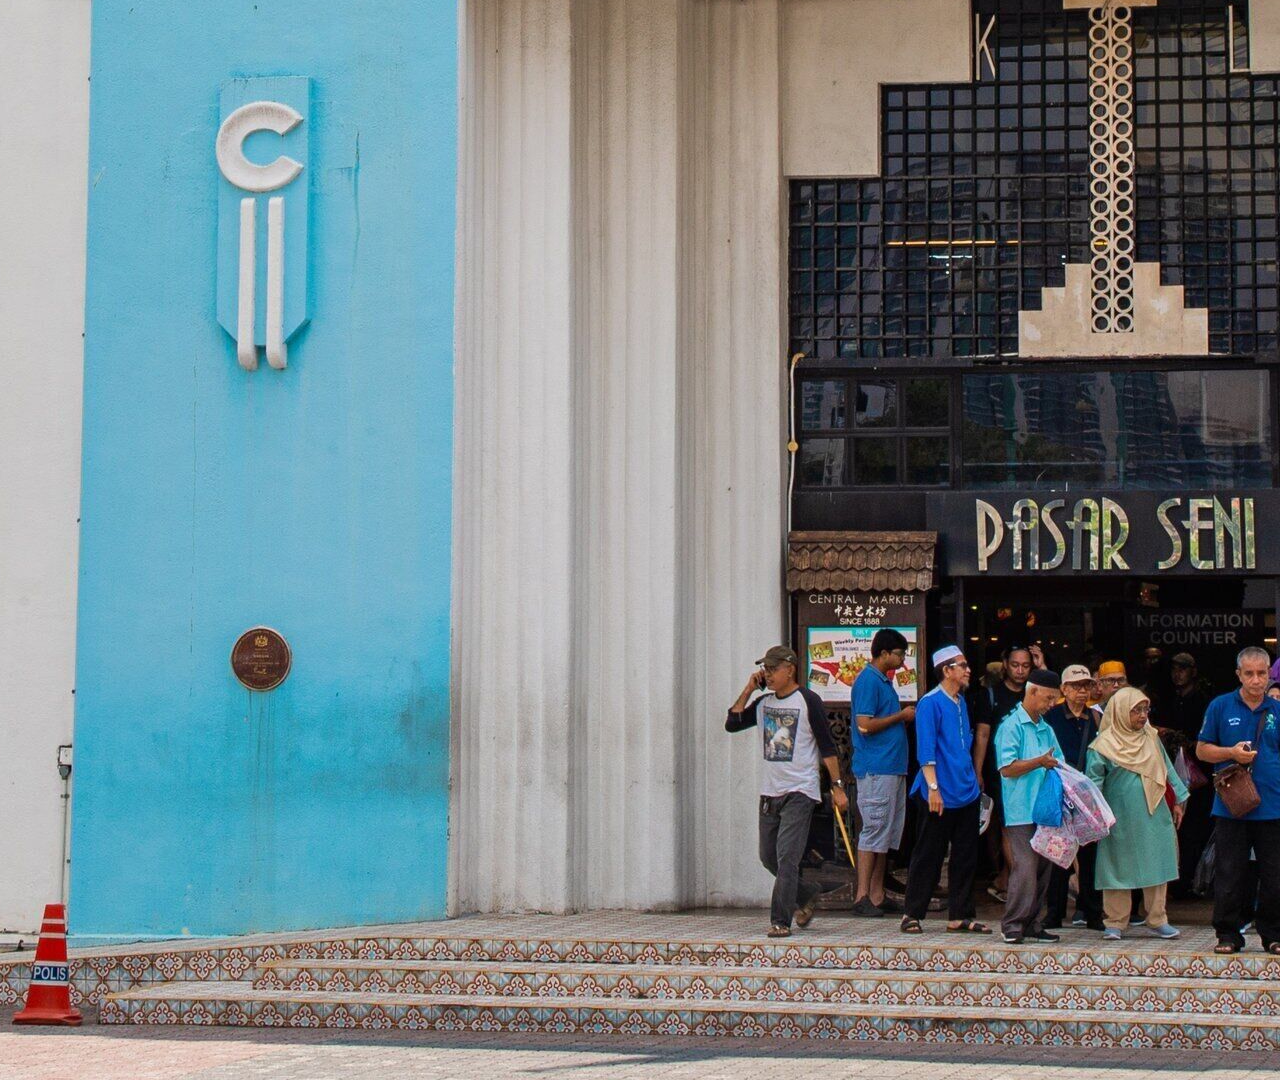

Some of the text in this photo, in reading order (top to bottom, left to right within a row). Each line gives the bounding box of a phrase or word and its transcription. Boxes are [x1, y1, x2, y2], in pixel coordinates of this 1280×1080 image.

[975, 494, 1257, 571] PASAR SENI
[809, 594, 915, 605] CENTRAL MARKET
[834, 604, 888, 617] 中央艺术坊
[839, 617, 880, 625] SINCE 1888
[1131, 613, 1254, 627] INFORMATION
[1150, 631, 1237, 645] COUNTER
[33, 966, 67, 981] POLIS
